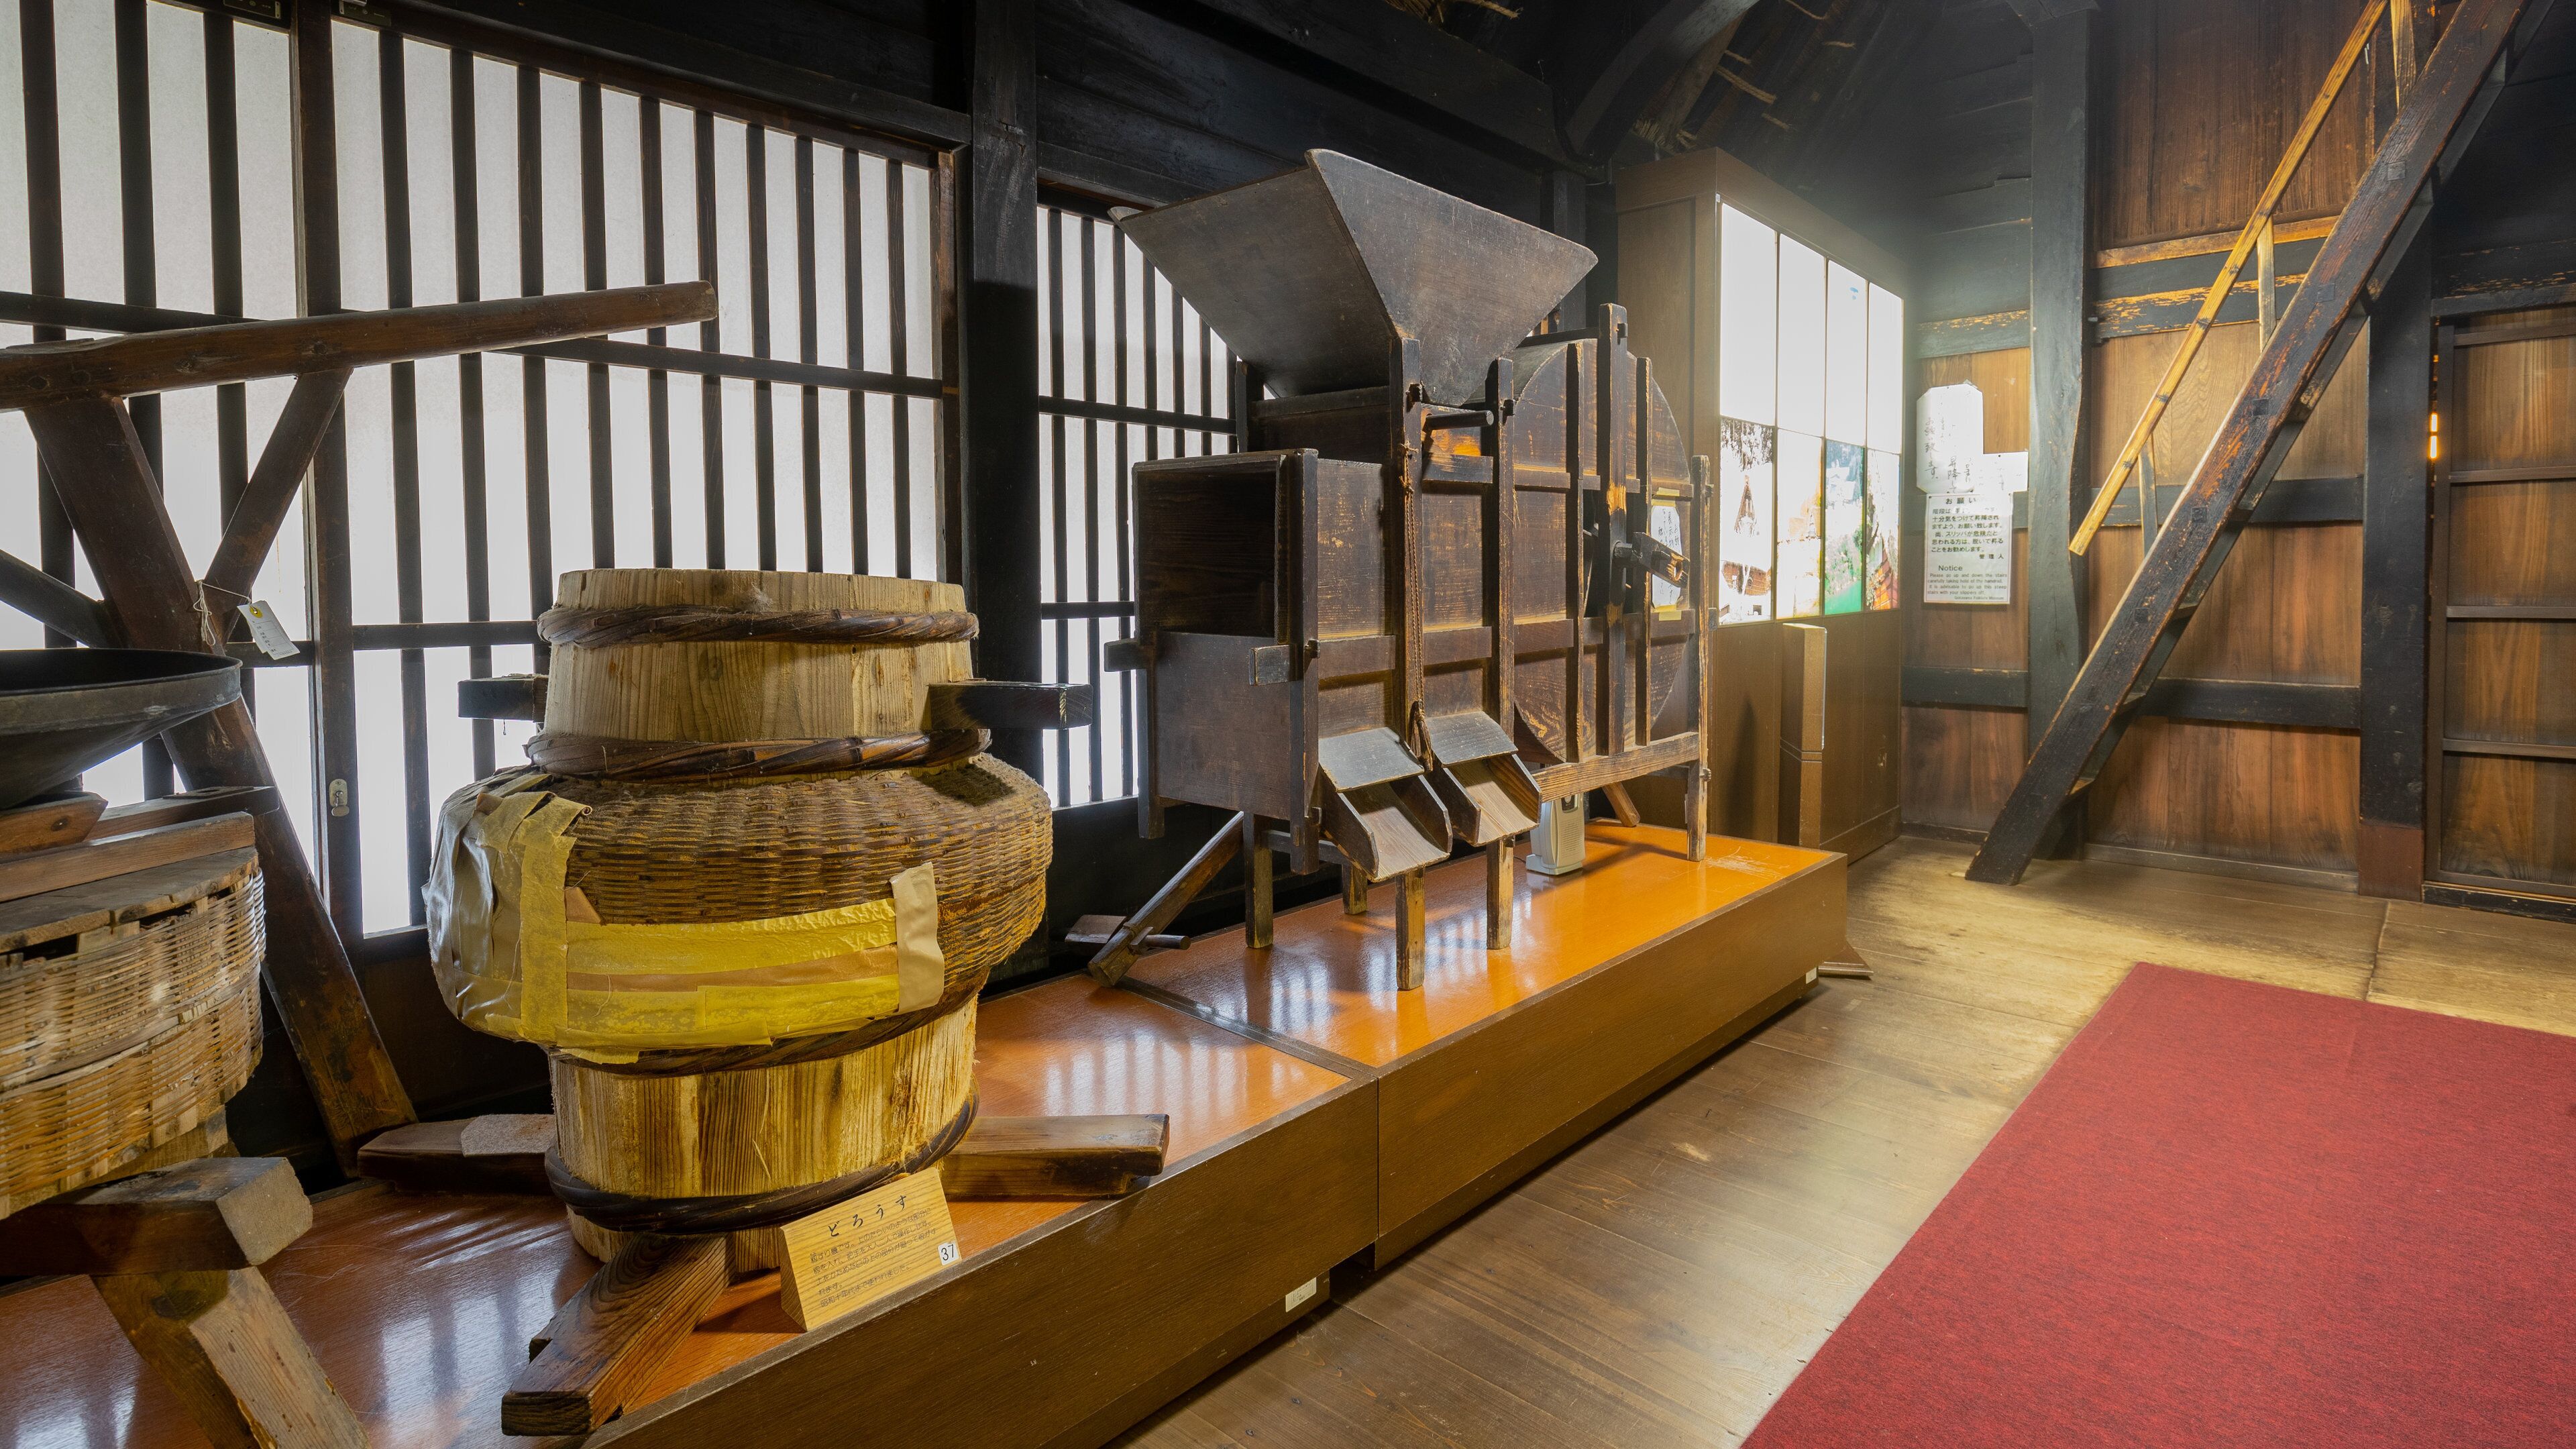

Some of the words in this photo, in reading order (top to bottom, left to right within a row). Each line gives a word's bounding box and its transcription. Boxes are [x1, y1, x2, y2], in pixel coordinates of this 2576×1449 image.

[1932, 515, 1999, 523] 十分気をつけて昇降され
[828, 1194, 907, 1238] どろうす
[940, 1243, 957, 1262] 37
[818, 1282, 843, 1296] れます。
